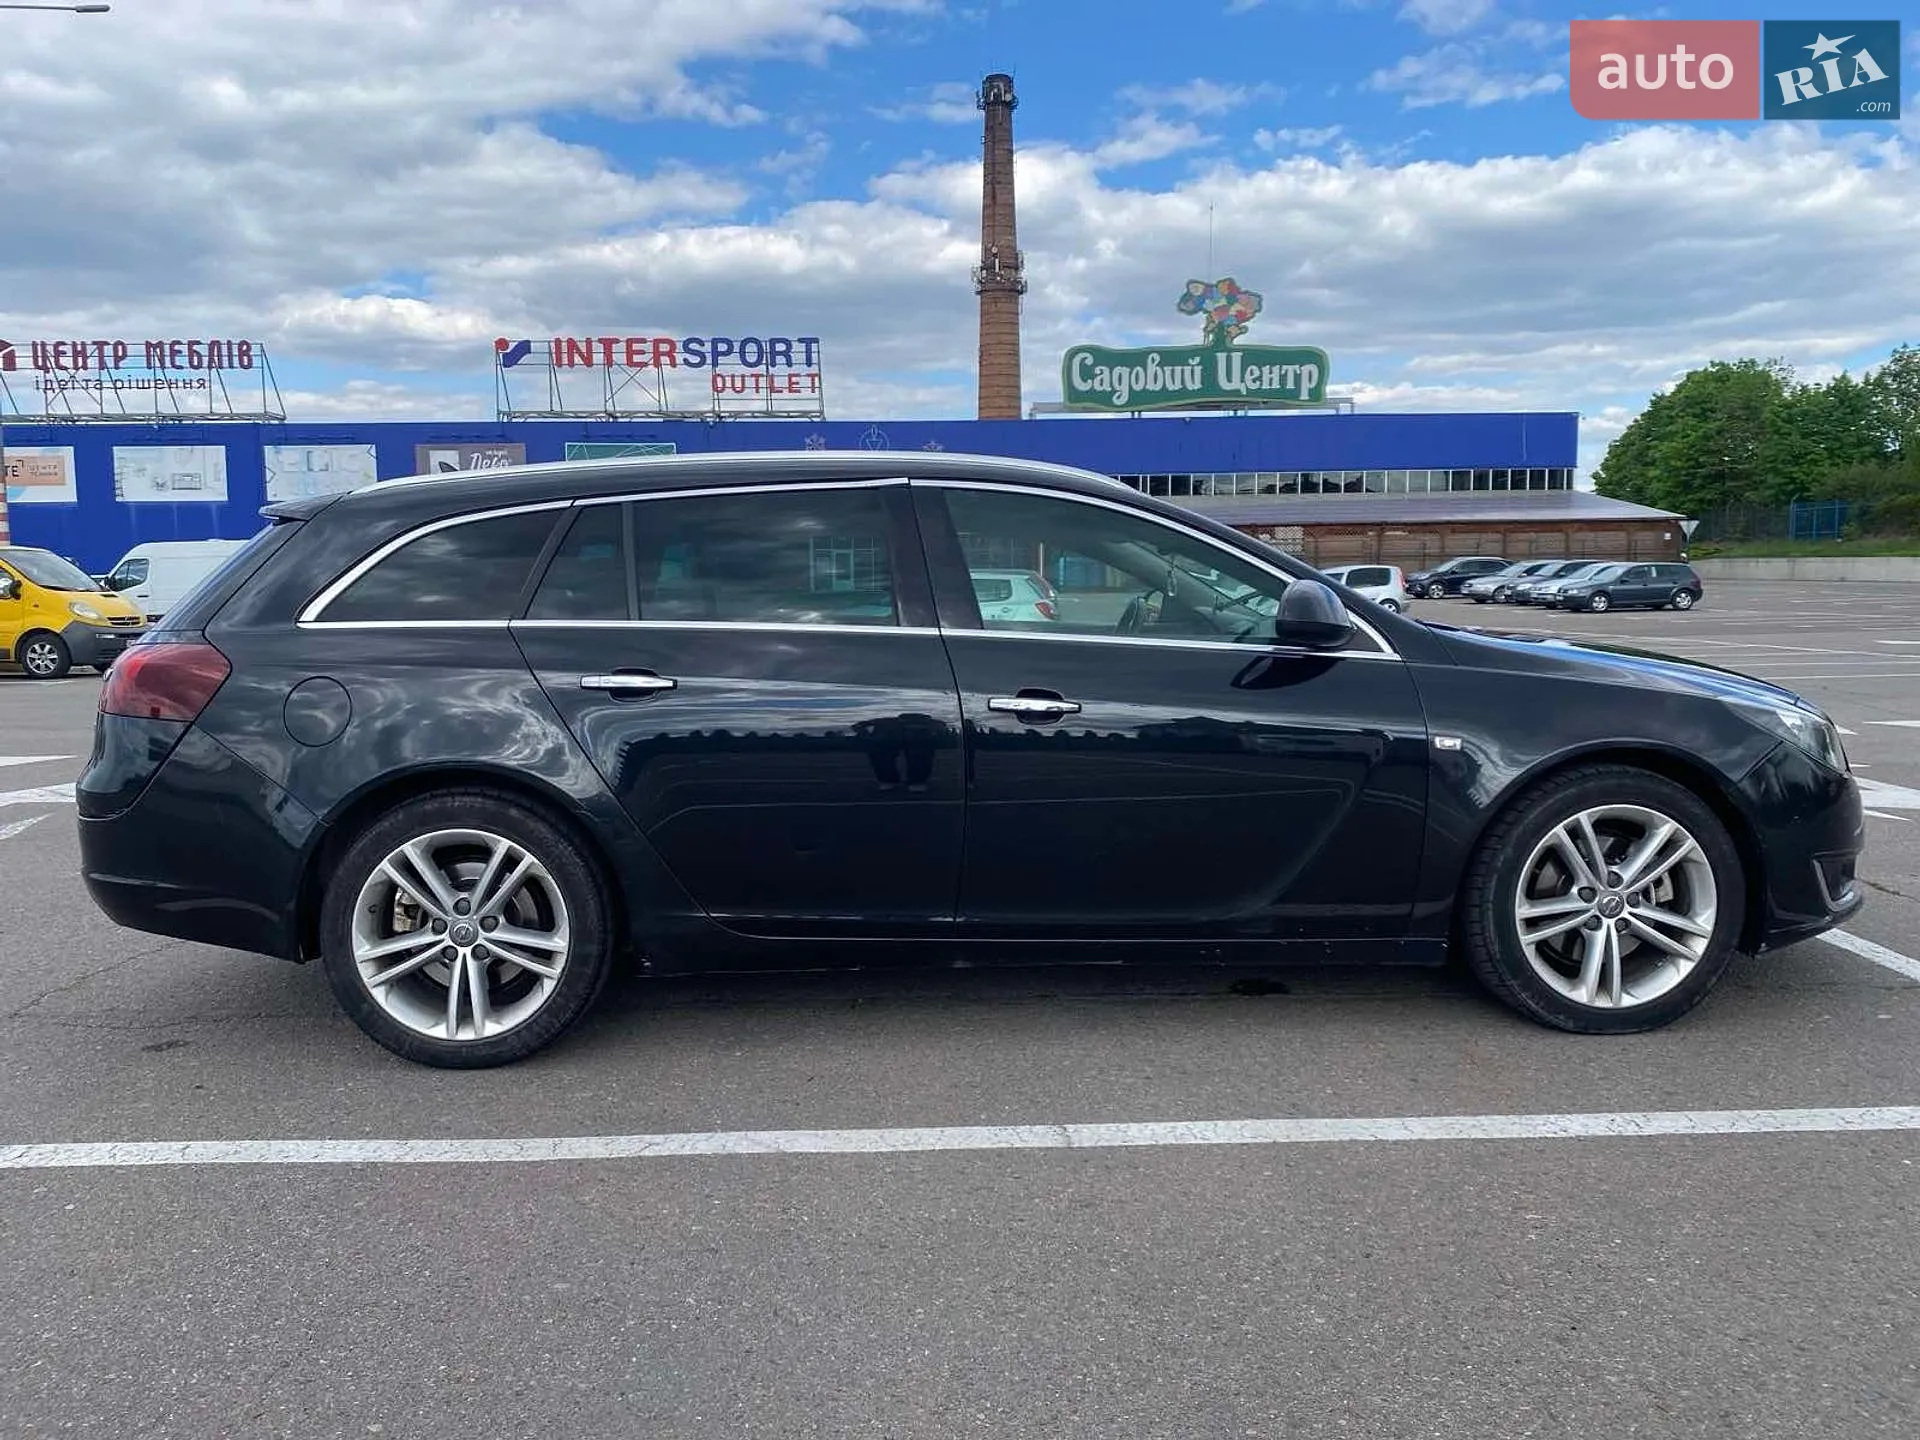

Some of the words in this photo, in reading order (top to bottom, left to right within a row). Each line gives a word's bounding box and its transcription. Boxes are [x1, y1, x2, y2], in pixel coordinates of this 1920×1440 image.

[31, 339, 128, 374] ЦЕНТР
[145, 339, 254, 370] МЕБЛІВ
[554, 337, 820, 369] INTERSPORT
[114, 374, 206, 393] рішення
[711, 373, 820, 394] OUTLET
[1071, 352, 1203, 405] Садовий
[1216, 352, 1319, 400] Центр
